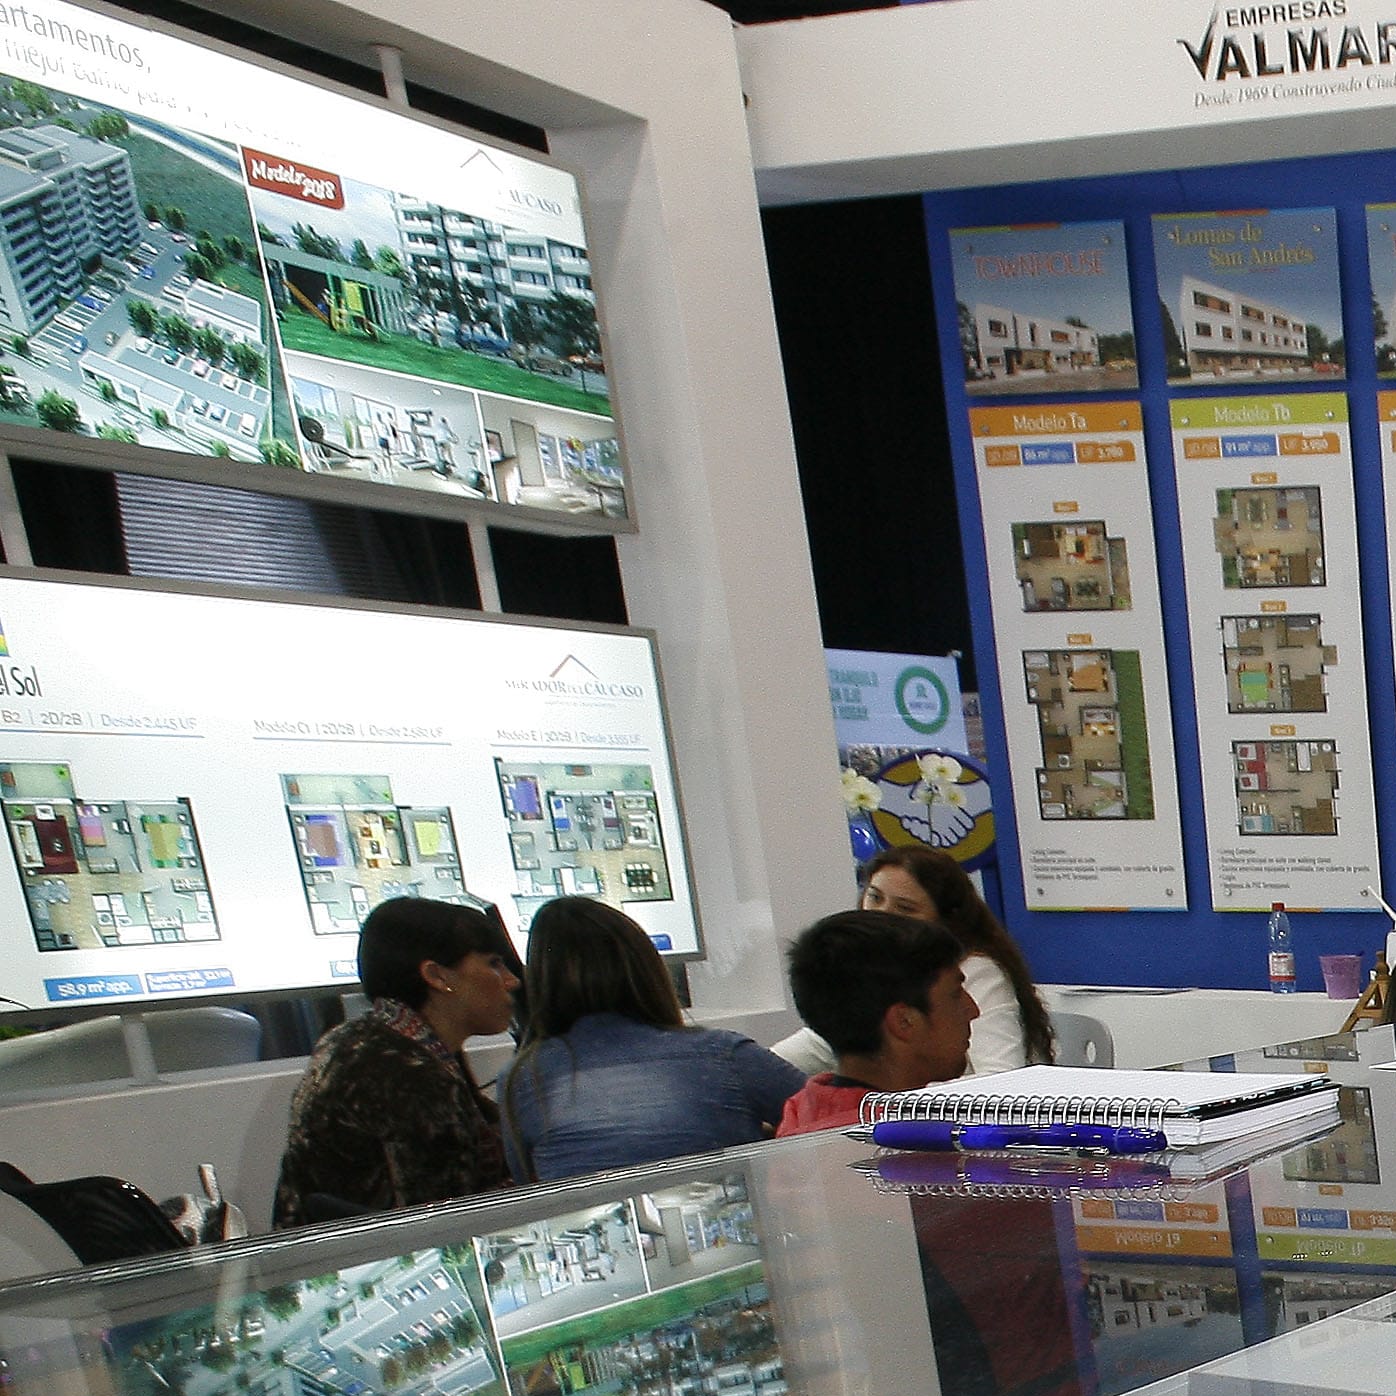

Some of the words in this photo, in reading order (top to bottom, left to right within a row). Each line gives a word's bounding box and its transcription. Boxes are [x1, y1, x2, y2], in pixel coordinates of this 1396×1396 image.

[1226, 0, 1346, 27] EMPRESAS
[1272, 76, 1362, 99] Construyendo
[1208, 247, 1242, 266] San
[11, 665, 43, 698] Sol
